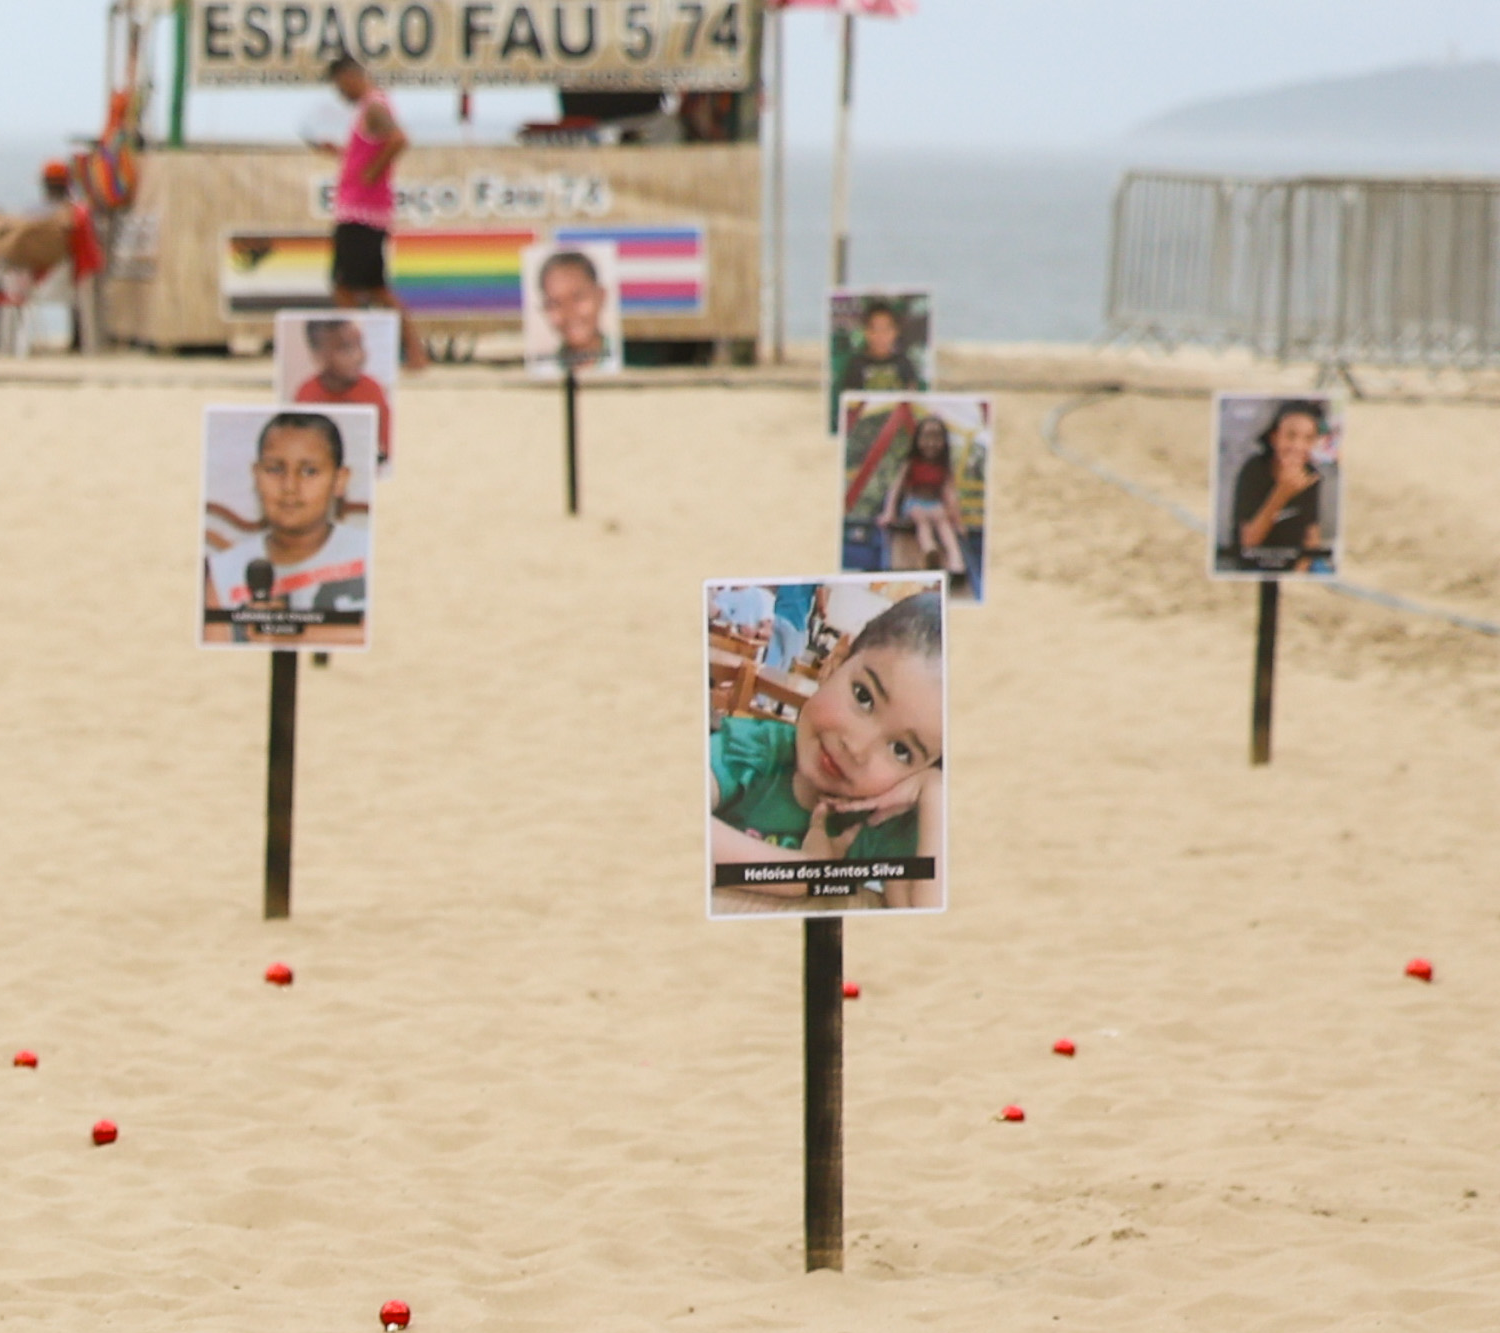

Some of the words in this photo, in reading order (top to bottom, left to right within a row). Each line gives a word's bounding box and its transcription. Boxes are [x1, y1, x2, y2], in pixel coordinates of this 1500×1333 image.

[463, 5, 595, 60] FAU
[678, 2, 739, 60] 74
[796, 865, 821, 880] dos
[823, 864, 870, 879] Santos
[871, 863, 905, 877] Silva
[813, 884, 820, 896] 3
[822, 884, 850, 895] Anos
